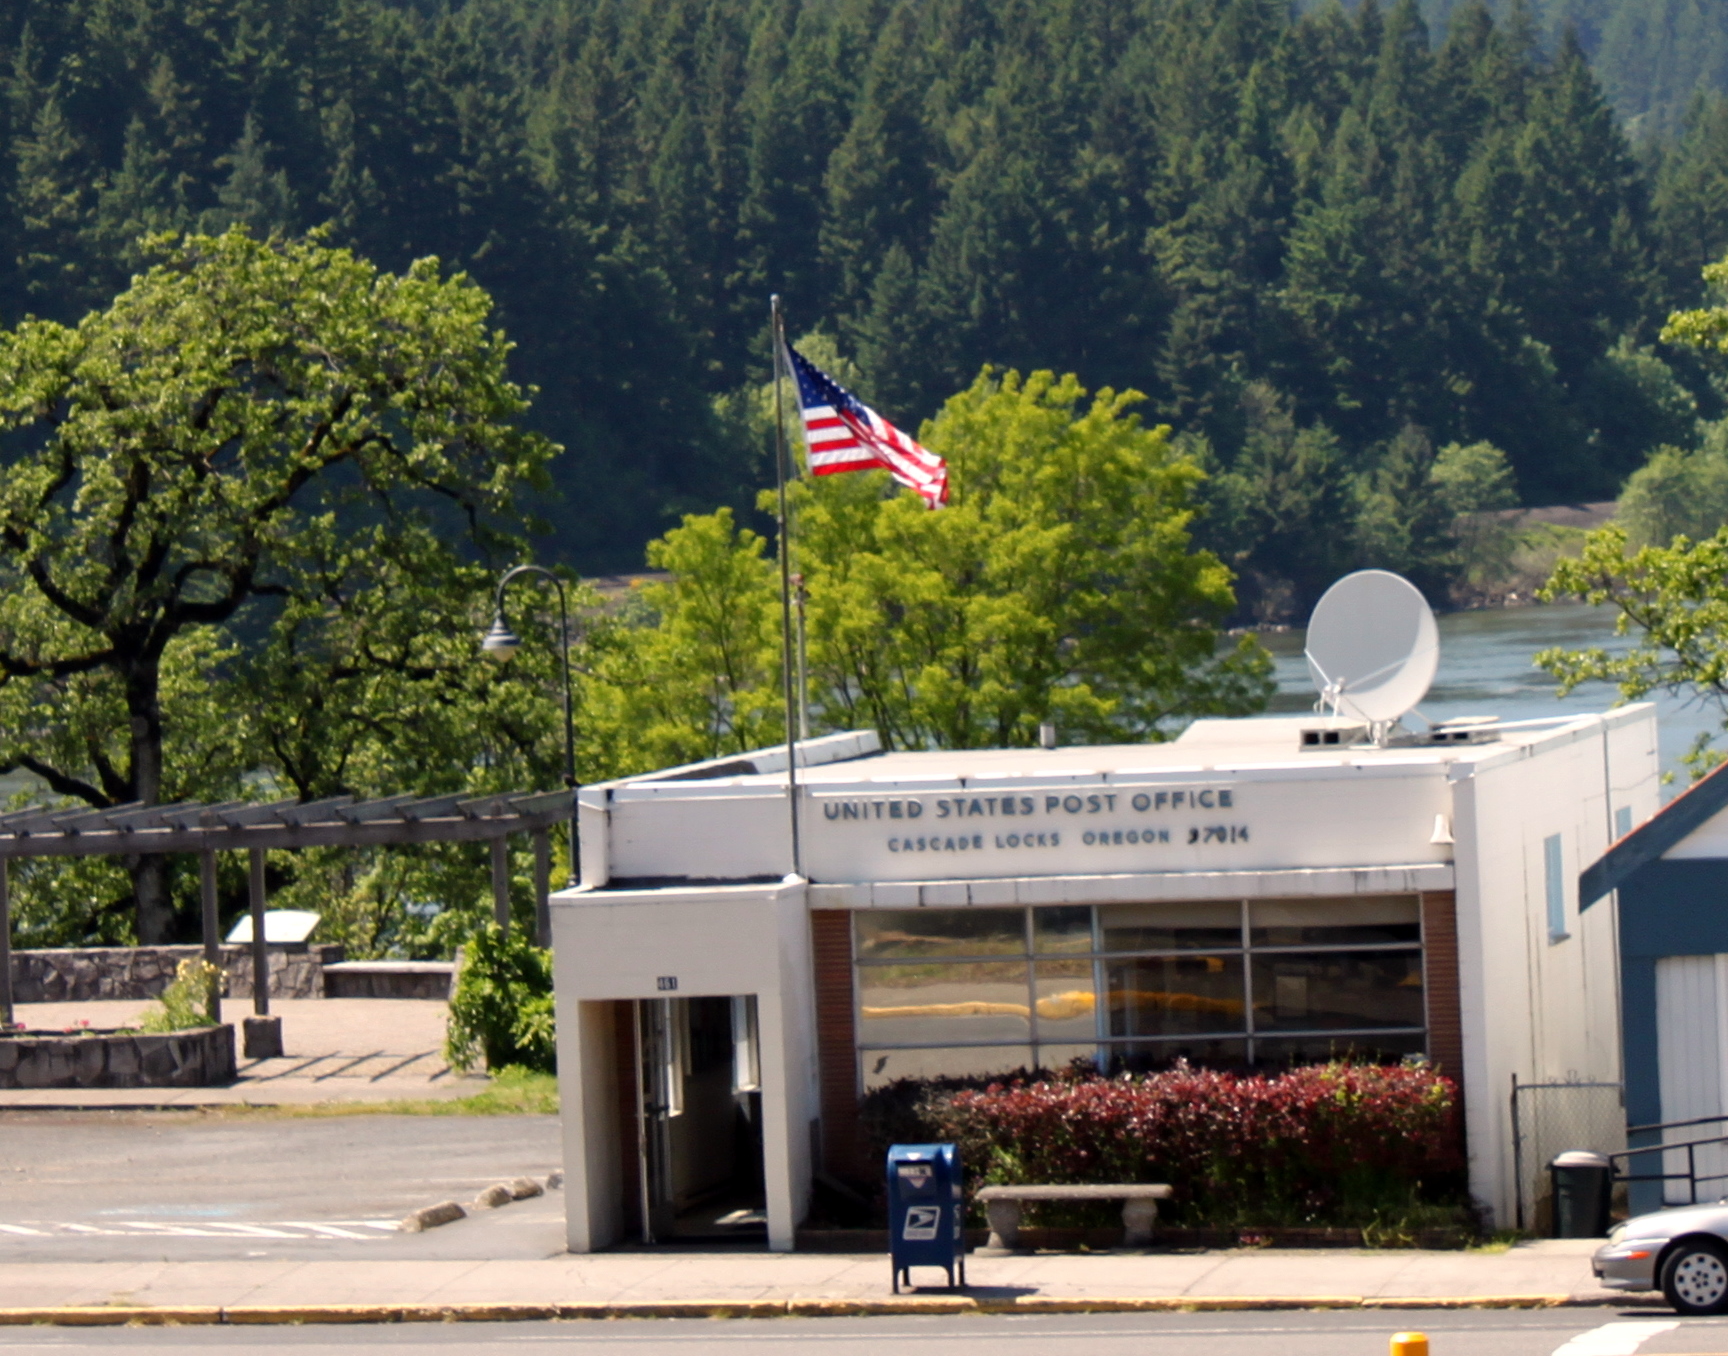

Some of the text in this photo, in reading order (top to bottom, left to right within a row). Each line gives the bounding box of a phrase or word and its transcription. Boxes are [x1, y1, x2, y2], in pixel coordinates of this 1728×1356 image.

[823, 789, 1234, 820] UNITED STATES POST OFFICE
[888, 834, 983, 852] CASCADE
[995, 831, 1060, 849] LOCKS
[1082, 828, 1170, 847] OREGON
